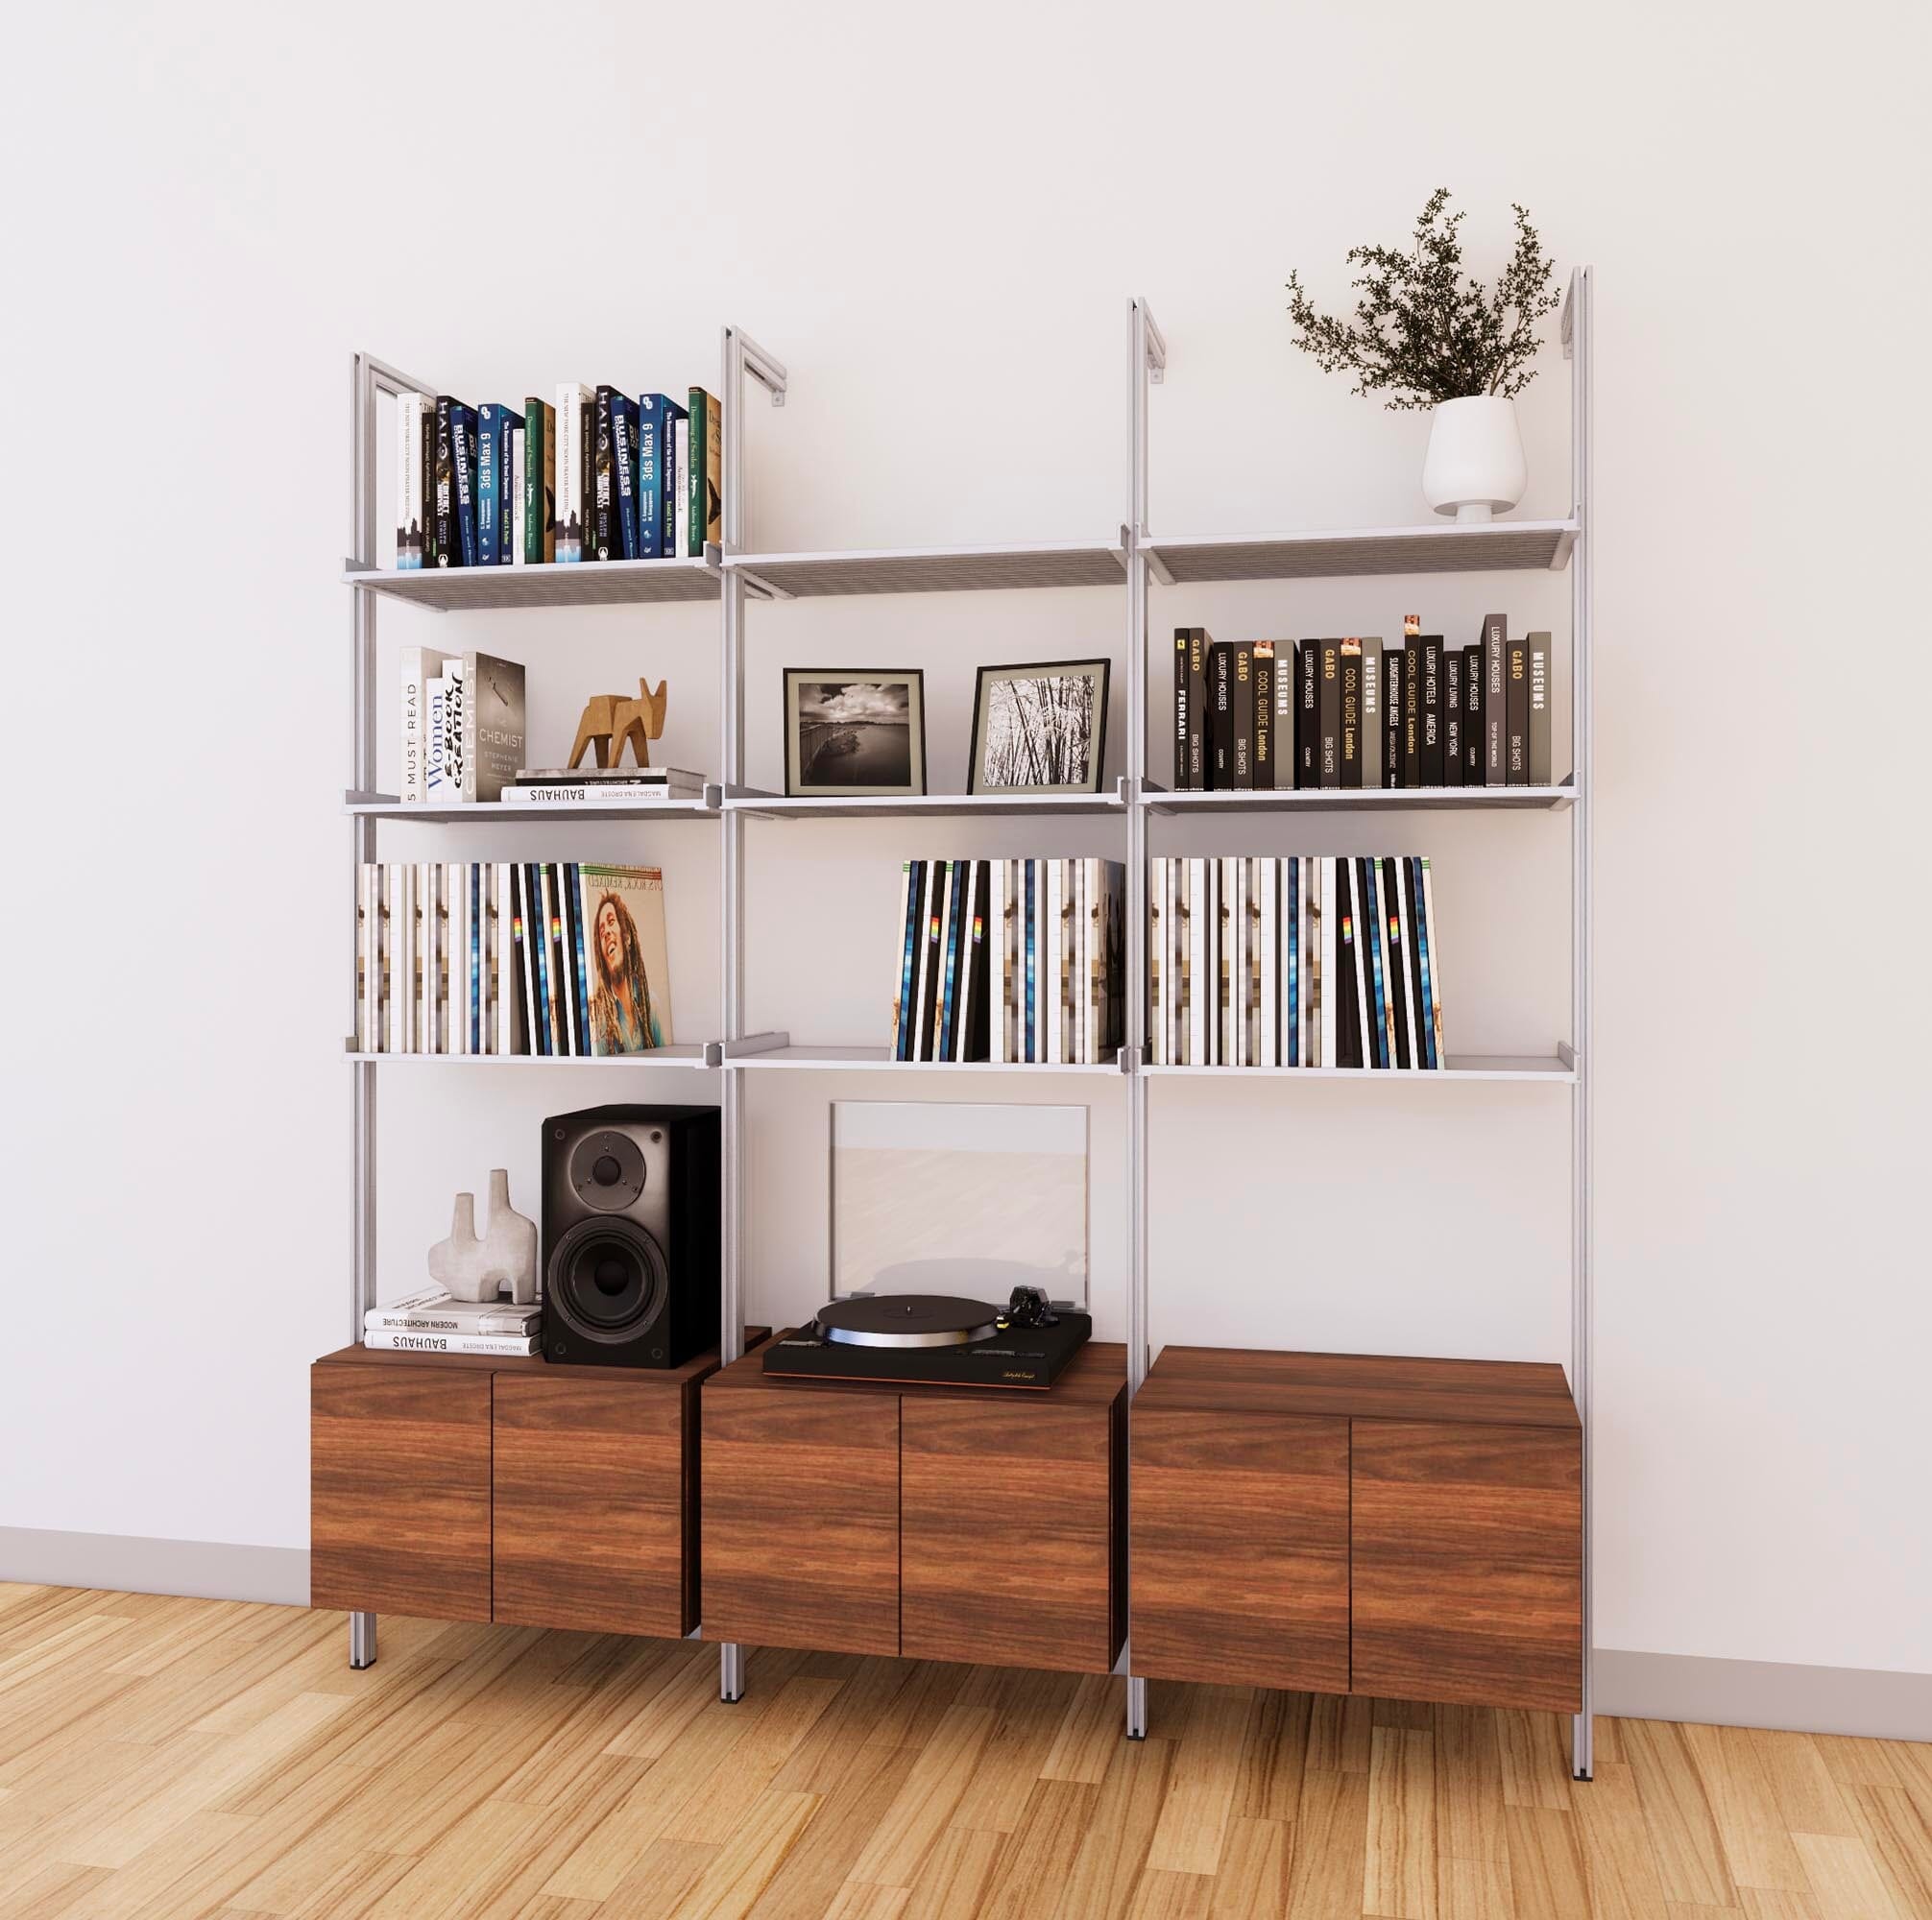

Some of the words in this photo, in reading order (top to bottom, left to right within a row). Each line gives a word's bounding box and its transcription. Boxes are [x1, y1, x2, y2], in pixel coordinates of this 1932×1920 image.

[437, 401, 447, 460] HALO
[596, 392, 608, 450] HALO
[480, 443, 491, 467] Max
[617, 415, 631, 496] BUSINESS
[642, 434, 653, 457] Max
[456, 424, 470, 505] BUSINESS
[642, 460, 653, 480] 3ds
[480, 469, 491, 489] 3ds
[1491, 627, 1500, 659] LUXURY
[1238, 652, 1247, 681] GABO
[1305, 650, 1314, 678] LUXURY
[1325, 649, 1335, 679] GABO
[1426, 646, 1436, 674] LUXURY
[1449, 660, 1458, 685] LUXURY
[1469, 656, 1478, 682] LUXURY
[1512, 650, 1523, 680] GABO
[1258, 671, 1268, 696] COOL
[1277, 660, 1288, 715] MUSEUMS
[1345, 668, 1356, 693] COOL
[1365, 657, 1376, 713] MUSEUMS
[1389, 658, 1399, 705] SLAUGHTERHOUSE
[1491, 660, 1500, 693] HOUSES
[1534, 652, 1544, 709] MUSEUMS
[1305, 679, 1314, 708] HOUSES
[1426, 677, 1436, 705] HOTELS
[1449, 687, 1458, 708] LIVING
[1469, 683, 1478, 711] HOUSES
[1258, 699, 1268, 726] GUIDE
[1345, 696, 1356, 724] GUIDE
[1389, 706, 1399, 726] ANGELS
[445, 684, 454, 778] E-BOOK
[451, 672, 463, 789] CREATION
[465, 660, 474, 794] CHEMIST
[480, 729, 522, 751] CHEMIST
[1426, 713, 1436, 745] AMERICA
[1449, 722, 1458, 737] NEW
[428, 696, 443, 789] Women
[1238, 739, 1246, 751] BIG
[1258, 730, 1268, 761] London
[1345, 728, 1356, 759] London
[1449, 738, 1458, 756] YORK
[1512, 736, 1521, 747] BIG
[1238, 752, 1246, 776] SHOTS
[1512, 748, 1521, 771] SHOTS
[529, 789, 585, 801] BAUHAUS
[382, 1319, 430, 1328] ARCHITECTURE
[431, 1321, 458, 1330] MODERN
[393, 1336, 447, 1350] BAUHAUS
